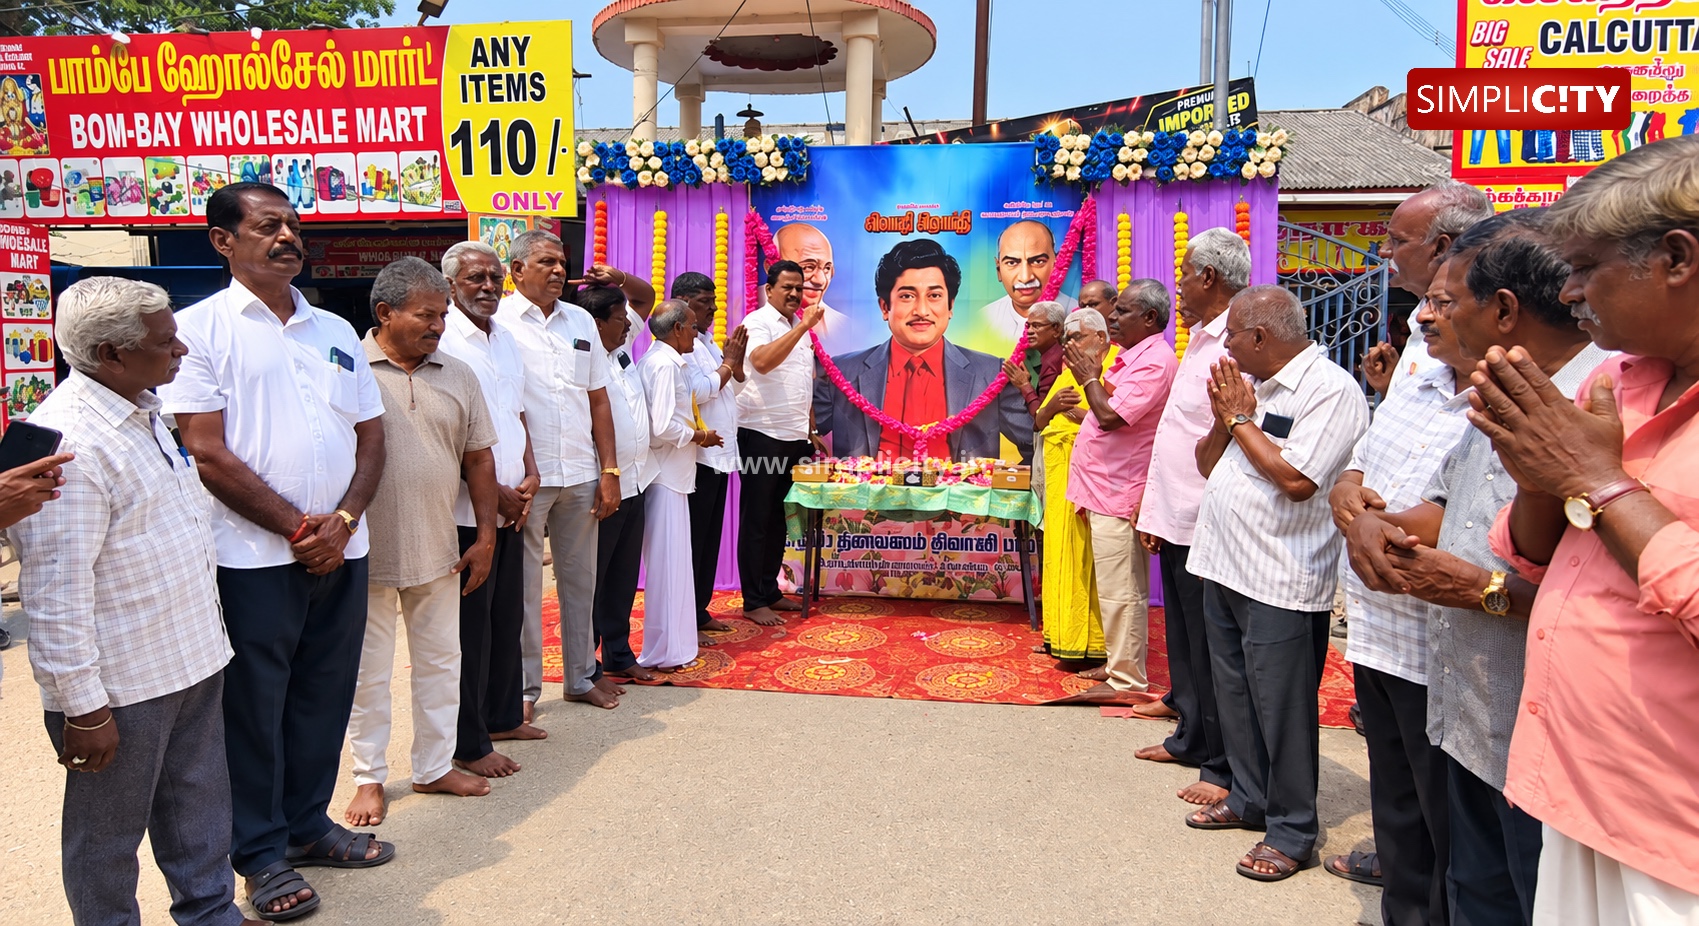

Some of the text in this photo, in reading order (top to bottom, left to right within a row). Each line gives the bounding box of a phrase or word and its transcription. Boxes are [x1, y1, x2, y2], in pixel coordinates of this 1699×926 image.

[1470, 20, 1509, 46] BIG
[471, 36, 530, 67] ANY
[1483, 47, 1533, 69] SALE
[48, 41, 152, 94] பாம்பே
[157, 39, 346, 107] ஹோல்சேல்
[460, 72, 546, 103] ITEMS
[69, 106, 428, 149] BOM-BAY WHOLESALE MART
[1158, 91, 1251, 133] IMPORED
[491, 191, 564, 211] ONLY
